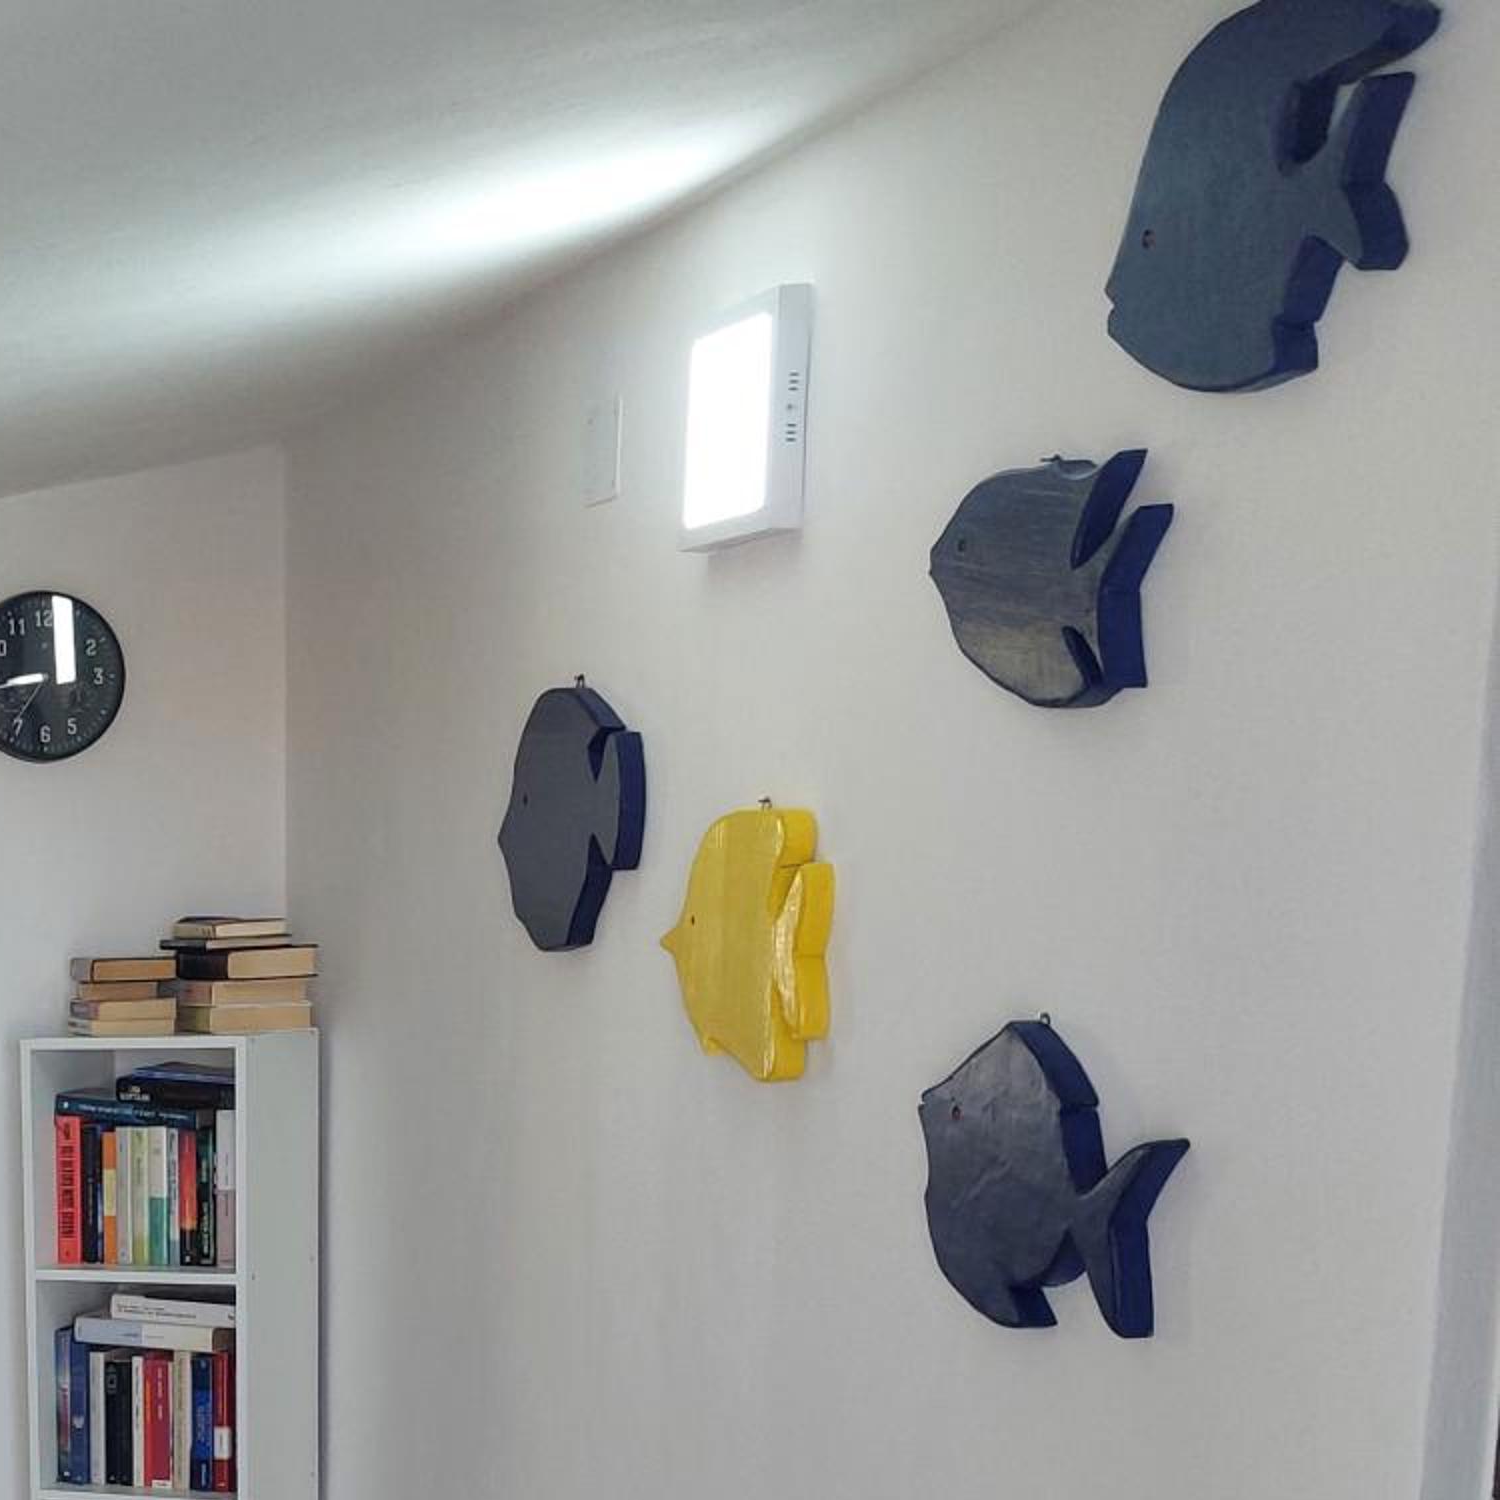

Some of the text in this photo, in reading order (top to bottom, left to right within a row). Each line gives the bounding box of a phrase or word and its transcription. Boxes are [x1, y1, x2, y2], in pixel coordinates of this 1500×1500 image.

[9, 618, 26, 636] 11
[35, 610, 53, 627] 12
[86, 639, 97, 656] 2
[93, 667, 104, 685] 3
[12, 718, 23, 736] 7
[40, 725, 51, 743] 6
[67, 717, 78, 735] 5
